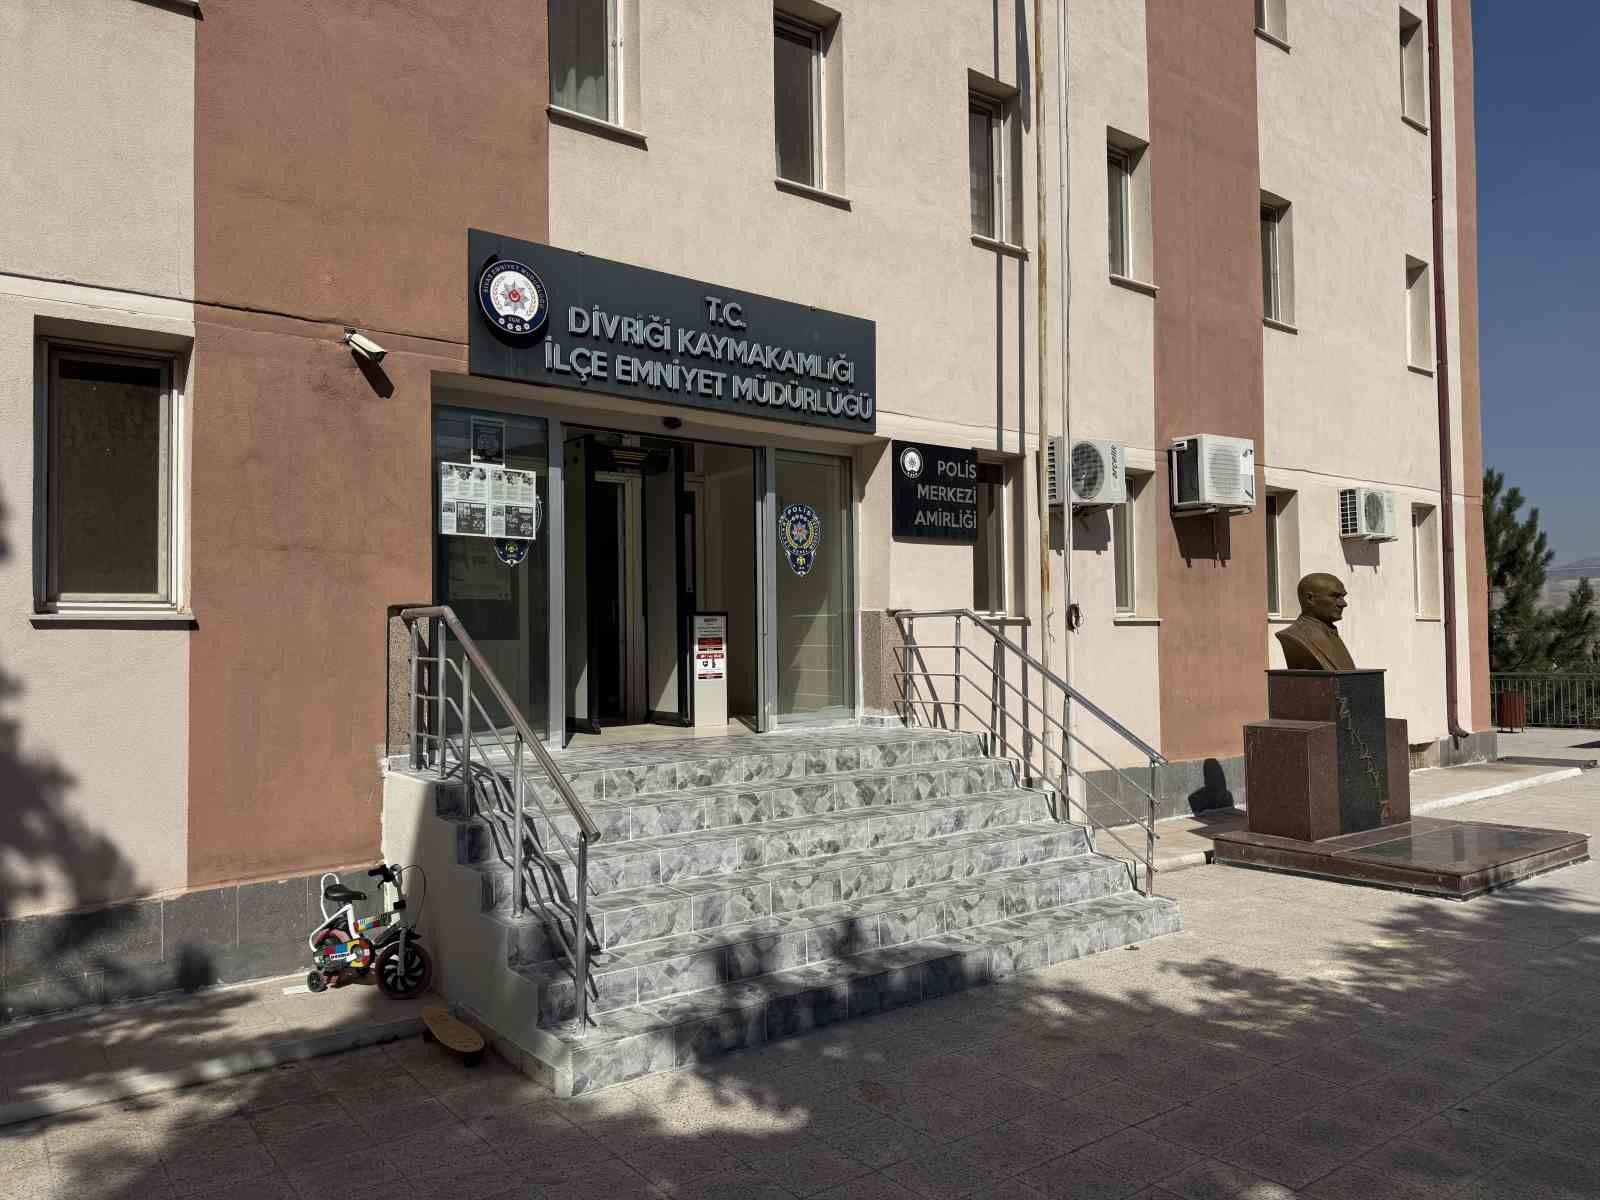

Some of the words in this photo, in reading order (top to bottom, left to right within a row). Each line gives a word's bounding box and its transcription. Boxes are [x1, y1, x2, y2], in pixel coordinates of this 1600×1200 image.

[705, 296, 747, 328] T.C.
[568, 304, 671, 350] DİVRİĞİ
[678, 328, 855, 384] KAYMAKAMLIĞI
[544, 335, 608, 382] İLÇE
[615, 354, 728, 397] EMNİYET
[732, 374, 873, 420] MÜDÜRLÜĞÜ
[937, 460, 977, 479] POLİS
[917, 483, 977, 504] MERKEZİ
[914, 508, 977, 529] AMİRLİĞİ
